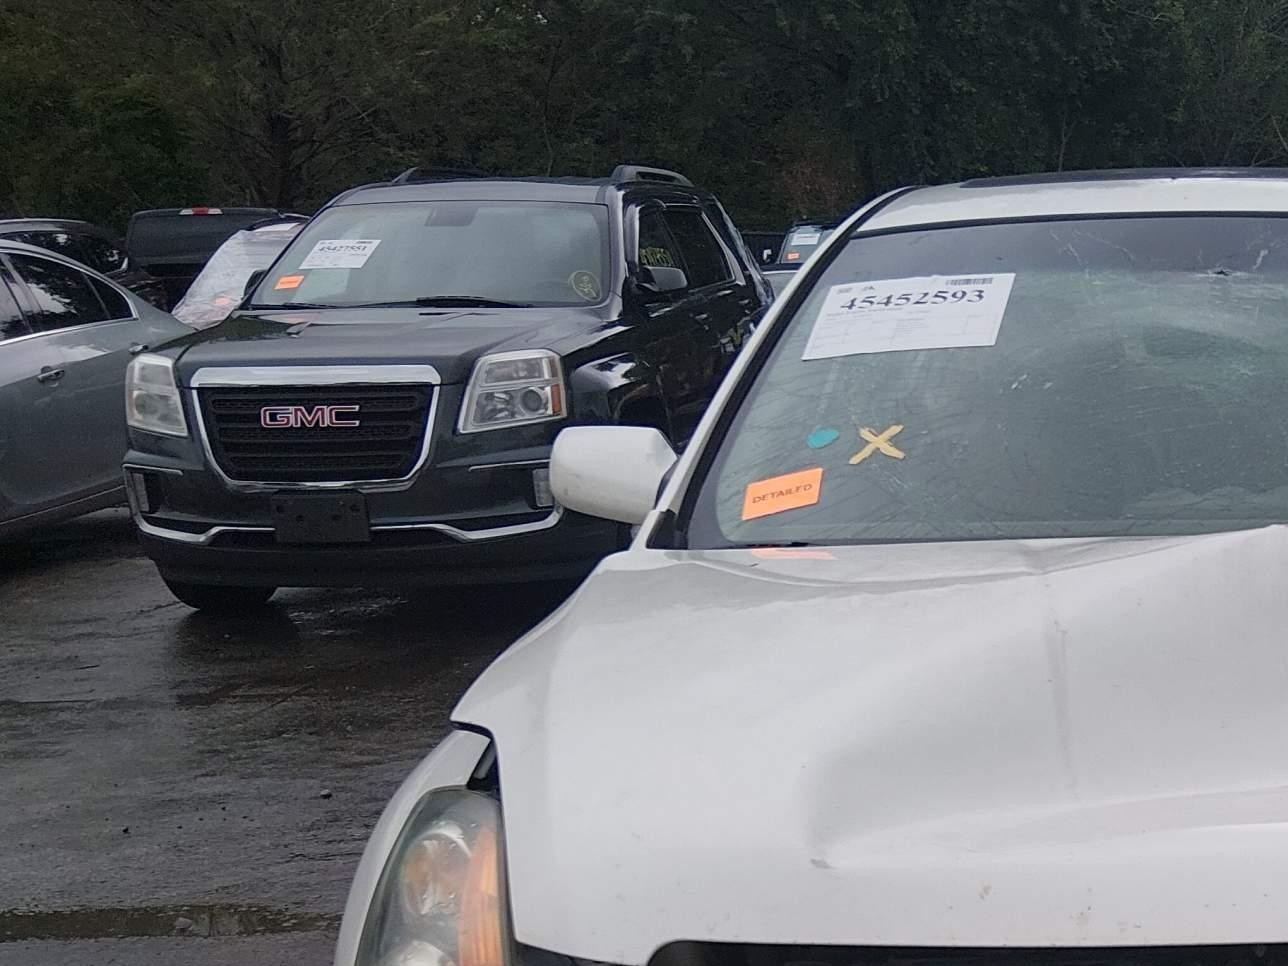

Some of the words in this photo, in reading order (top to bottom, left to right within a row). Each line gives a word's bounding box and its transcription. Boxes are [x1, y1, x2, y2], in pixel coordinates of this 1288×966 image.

[841, 289, 985, 310] 45452593
[261, 405, 360, 428] GMC
[752, 483, 812, 503] DETAILED
